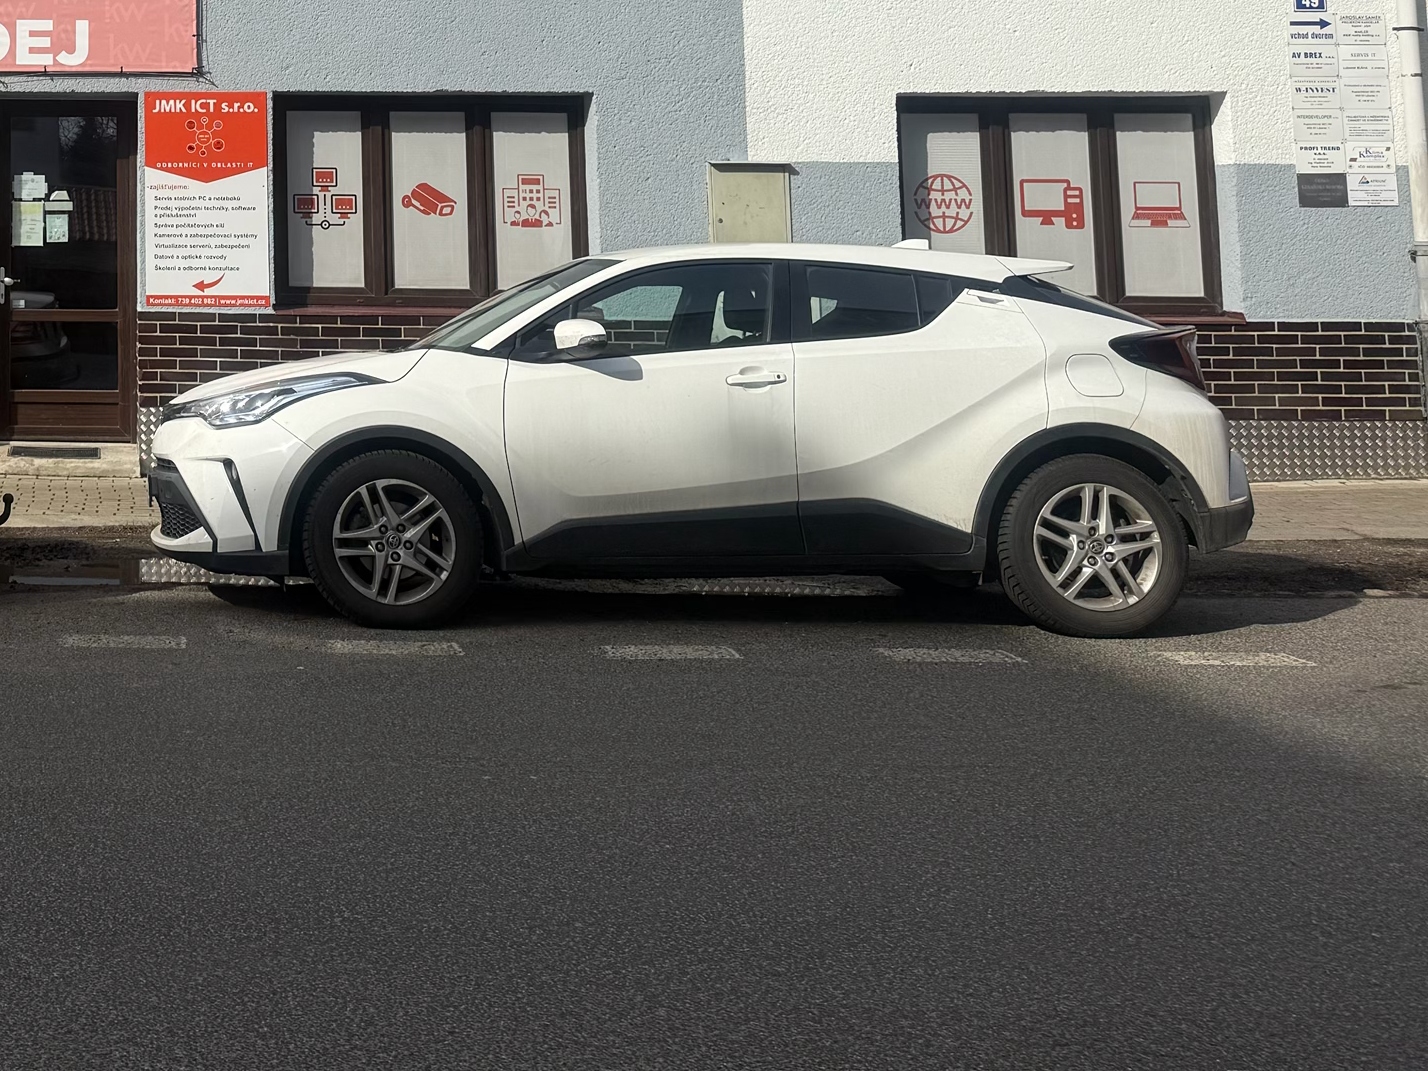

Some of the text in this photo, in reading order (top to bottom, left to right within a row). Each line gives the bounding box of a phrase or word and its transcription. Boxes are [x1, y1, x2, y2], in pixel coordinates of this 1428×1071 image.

[1289, 32, 1309, 40] vchod
[1310, 32, 1334, 40] dvorem
[1303, 51, 1323, 59] BREX
[152, 99, 259, 113] JMK ICT s.r.o.
[219, 297, 266, 306] www.jmkict.cz
